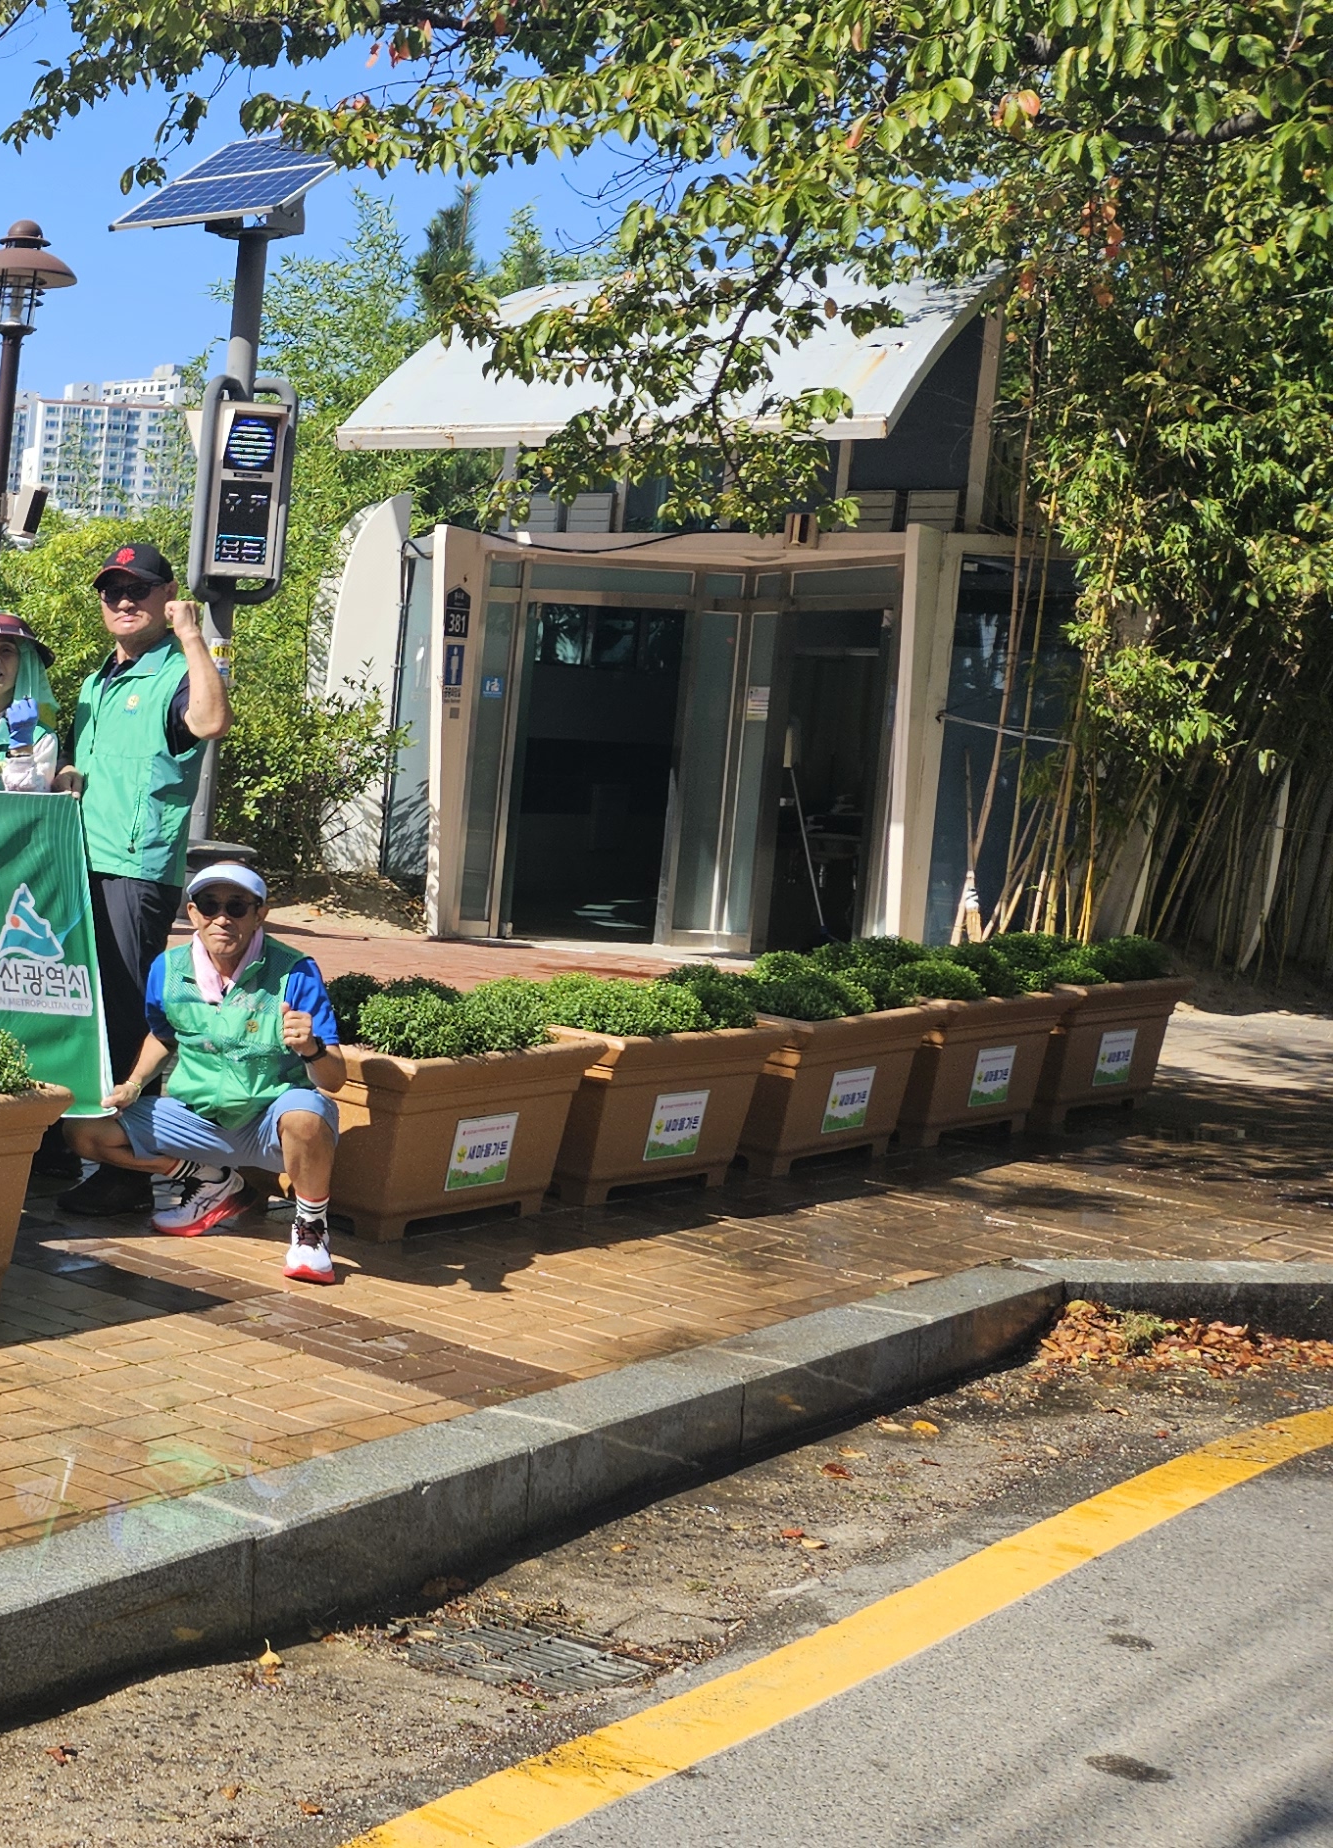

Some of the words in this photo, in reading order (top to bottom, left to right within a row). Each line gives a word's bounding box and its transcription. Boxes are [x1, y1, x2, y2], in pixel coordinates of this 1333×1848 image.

[448, 613, 466, 633] 381
[7, 998, 70, 1010] METROPOLITAN
[71, 1003, 89, 1011] CITY
[467, 1140, 508, 1160] 새마을가든
